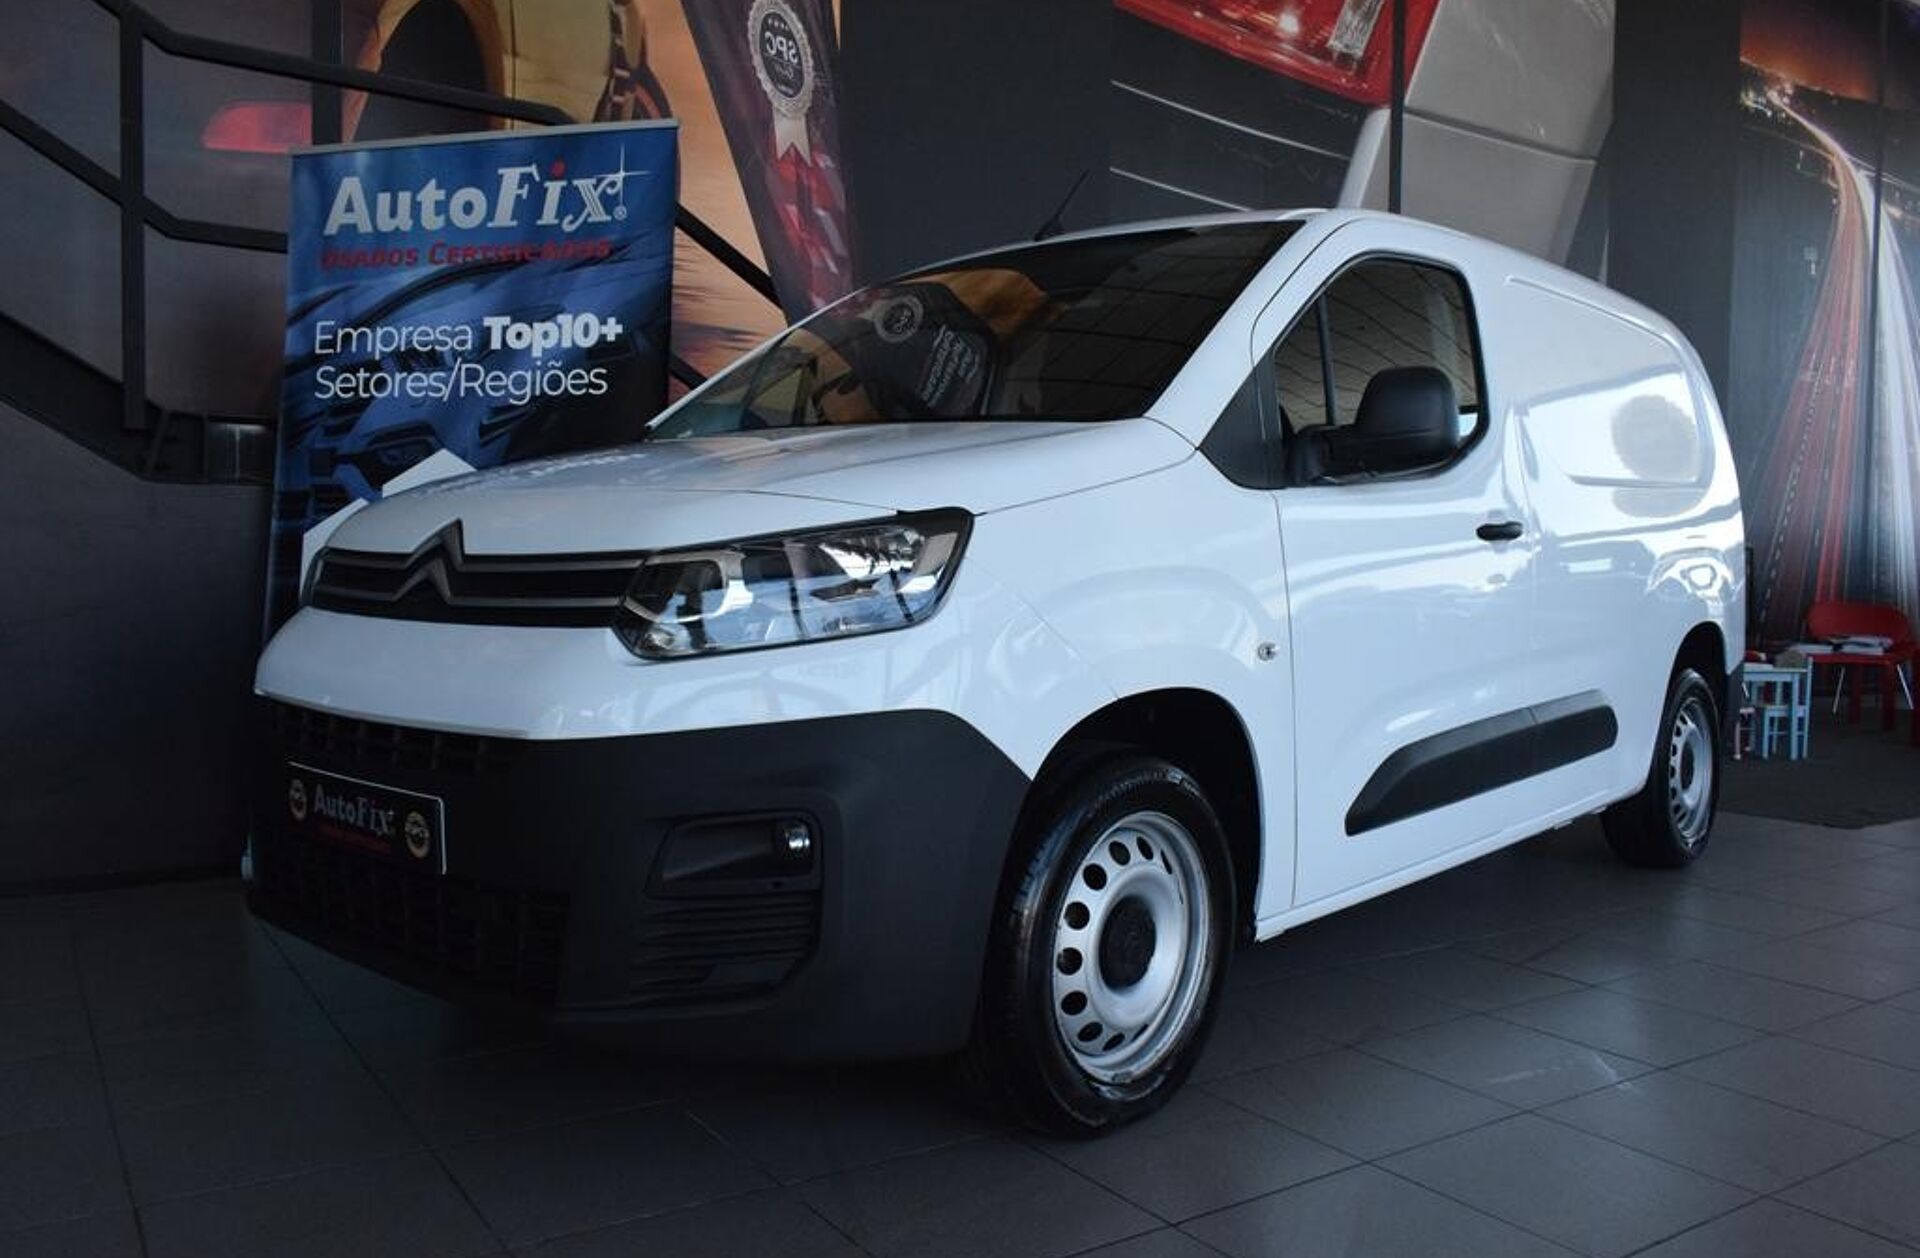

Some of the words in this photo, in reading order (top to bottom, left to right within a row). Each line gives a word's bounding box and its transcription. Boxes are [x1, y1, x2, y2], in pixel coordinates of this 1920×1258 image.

[314, 319, 472, 359] Empresa
[483, 312, 623, 357] Top10+
[314, 358, 608, 405] Setores/Regiões
[313, 783, 392, 837] AutoFix
